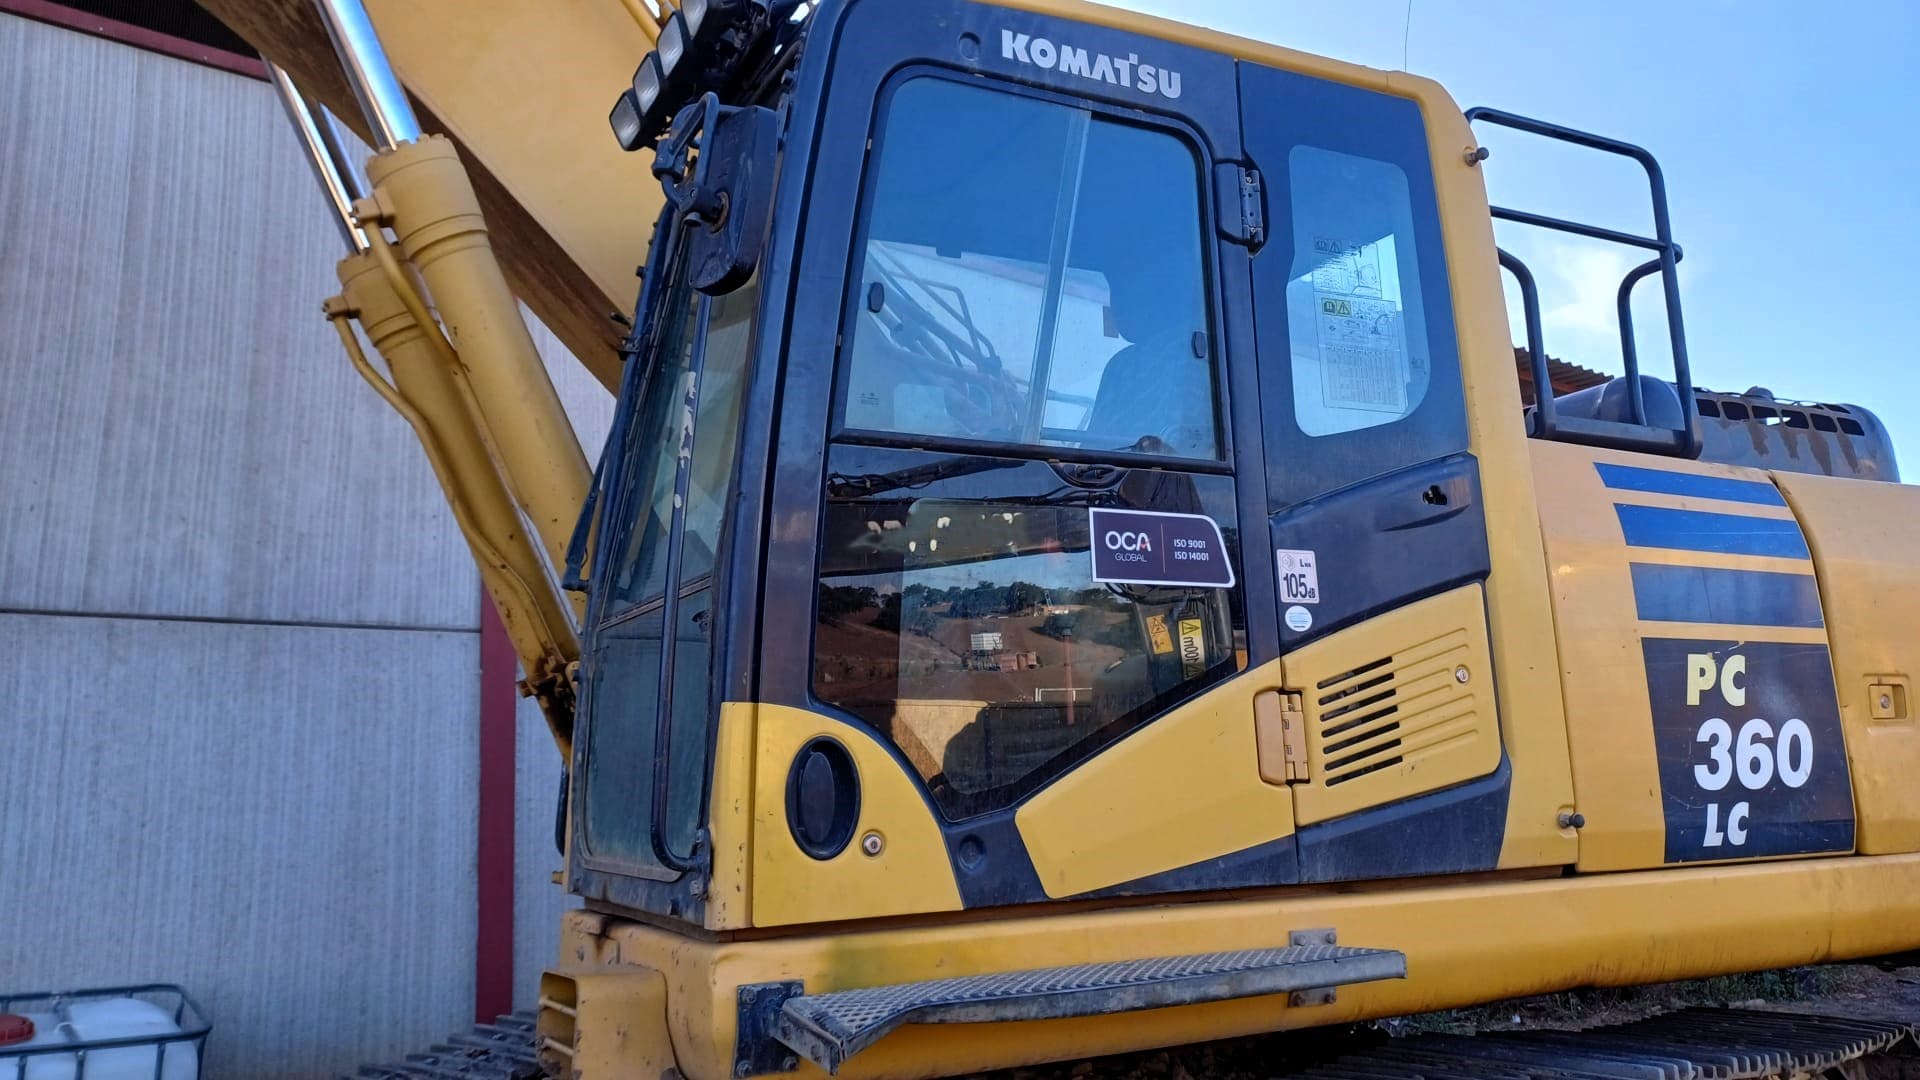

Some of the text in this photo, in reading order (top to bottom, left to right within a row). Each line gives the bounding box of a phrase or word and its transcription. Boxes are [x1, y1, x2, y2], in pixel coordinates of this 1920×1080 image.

[1001, 29, 1182, 99] KOMATSU
[1105, 530, 1152, 552] OCA
[1115, 552, 1148, 563] GLOBAL
[1173, 539, 1206, 549] ISO 9001
[1174, 551, 1209, 561] ISO 14001
[1686, 653, 1746, 707] PC
[1694, 718, 1814, 791] 360
[1703, 801, 1750, 847] LC
